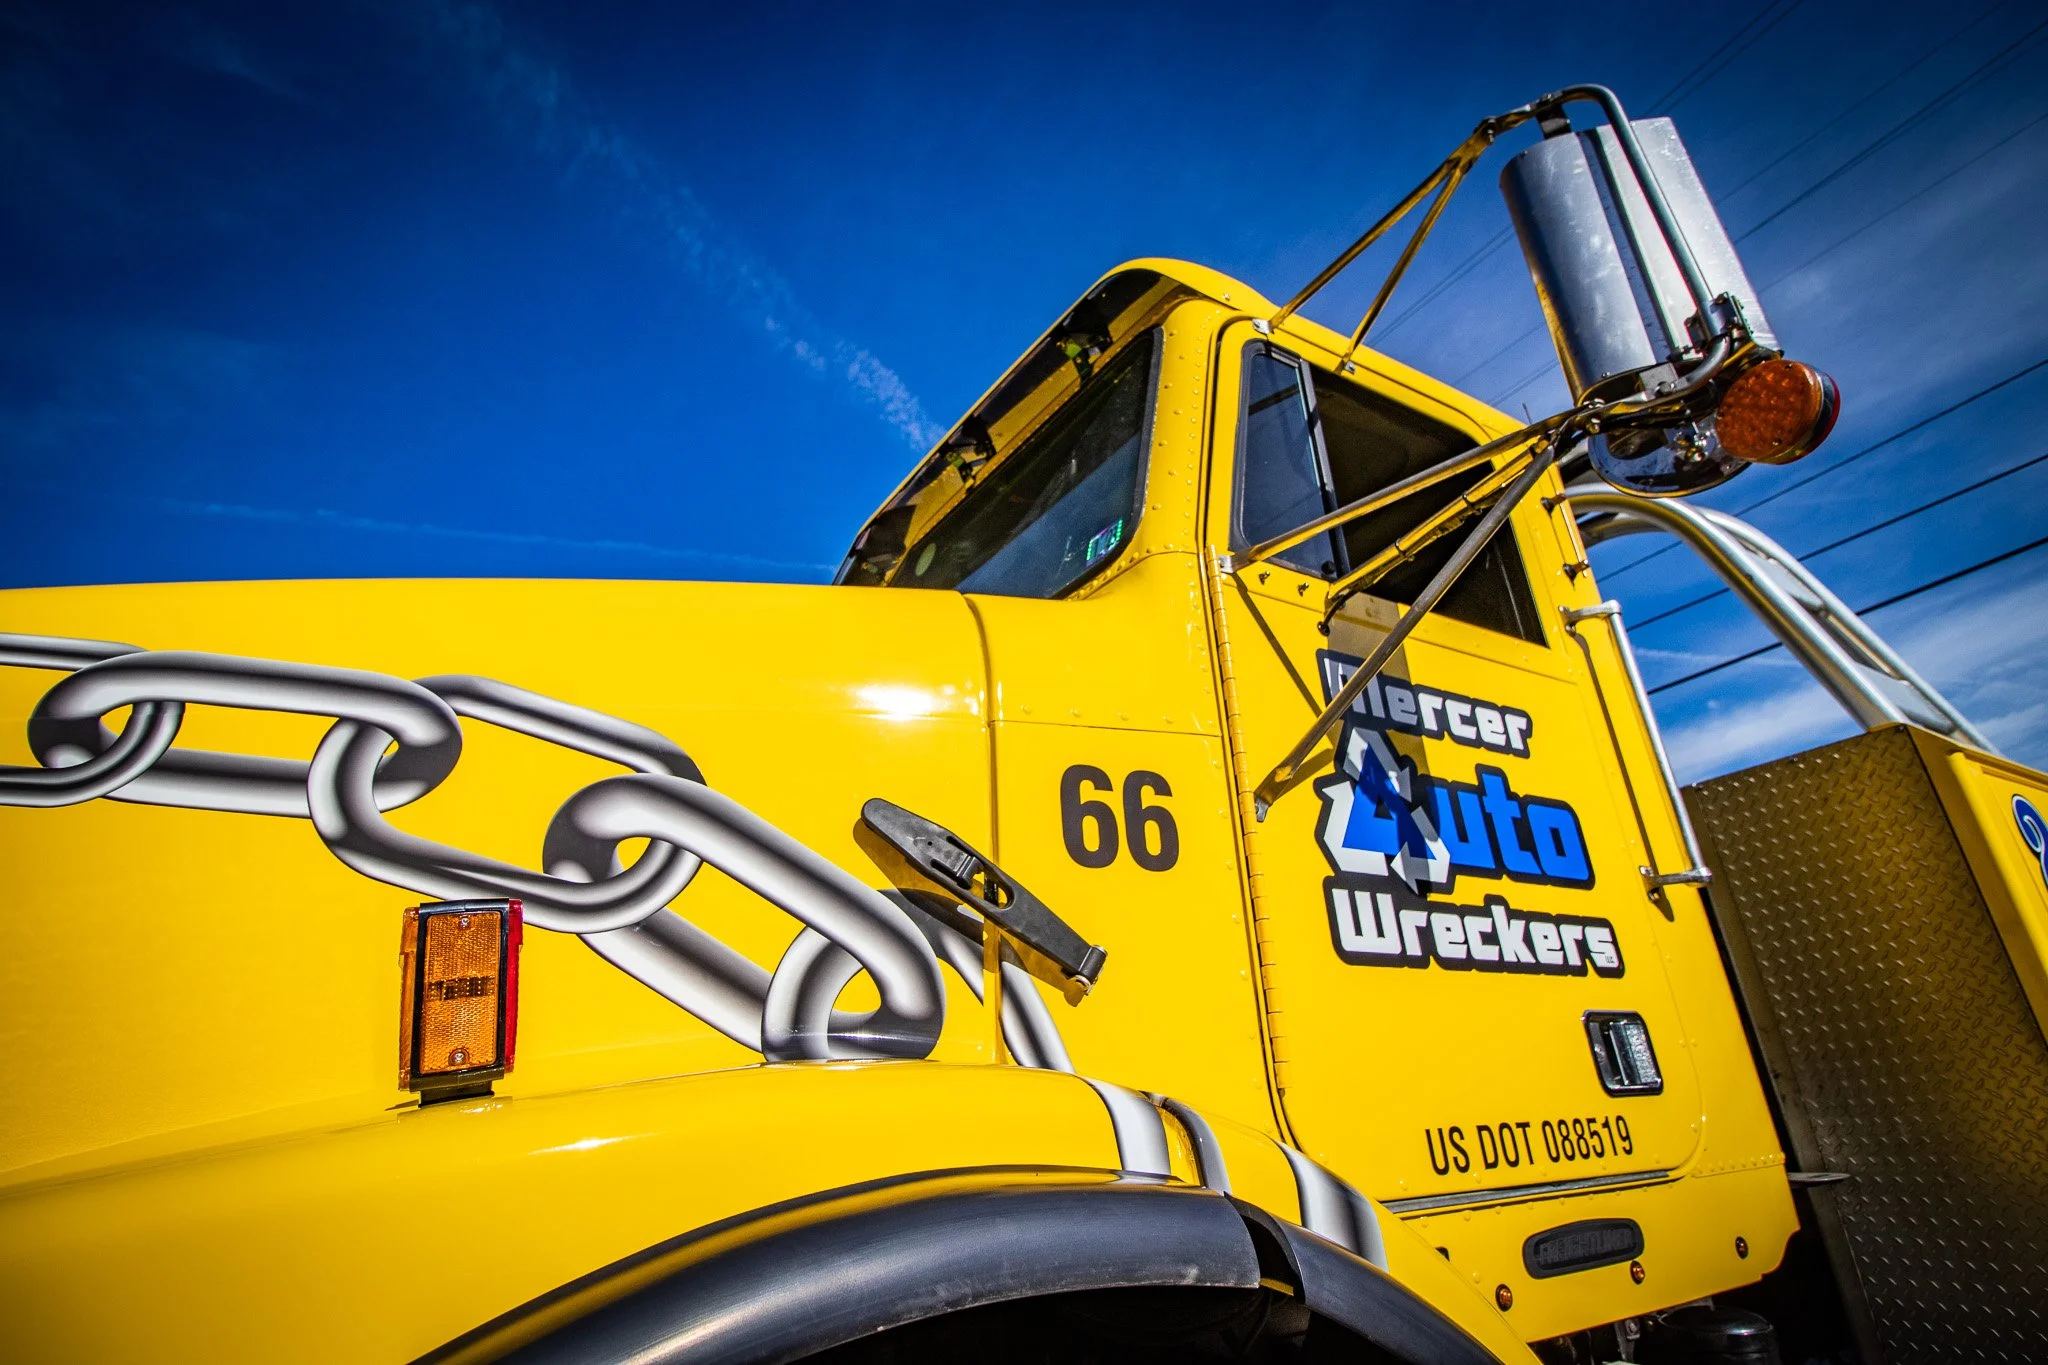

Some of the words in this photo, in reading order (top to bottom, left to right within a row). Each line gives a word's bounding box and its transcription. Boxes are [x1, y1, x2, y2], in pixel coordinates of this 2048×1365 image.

[1323, 658, 1527, 750] Mercer
[1060, 764, 1179, 872] 66
[1342, 744, 1590, 881] Auto
[1331, 888, 1620, 968] Wreckers
[1425, 1126, 1470, 1176] US
[1476, 1122, 1534, 1170] DOT
[1541, 1115, 1633, 1163] 088519
